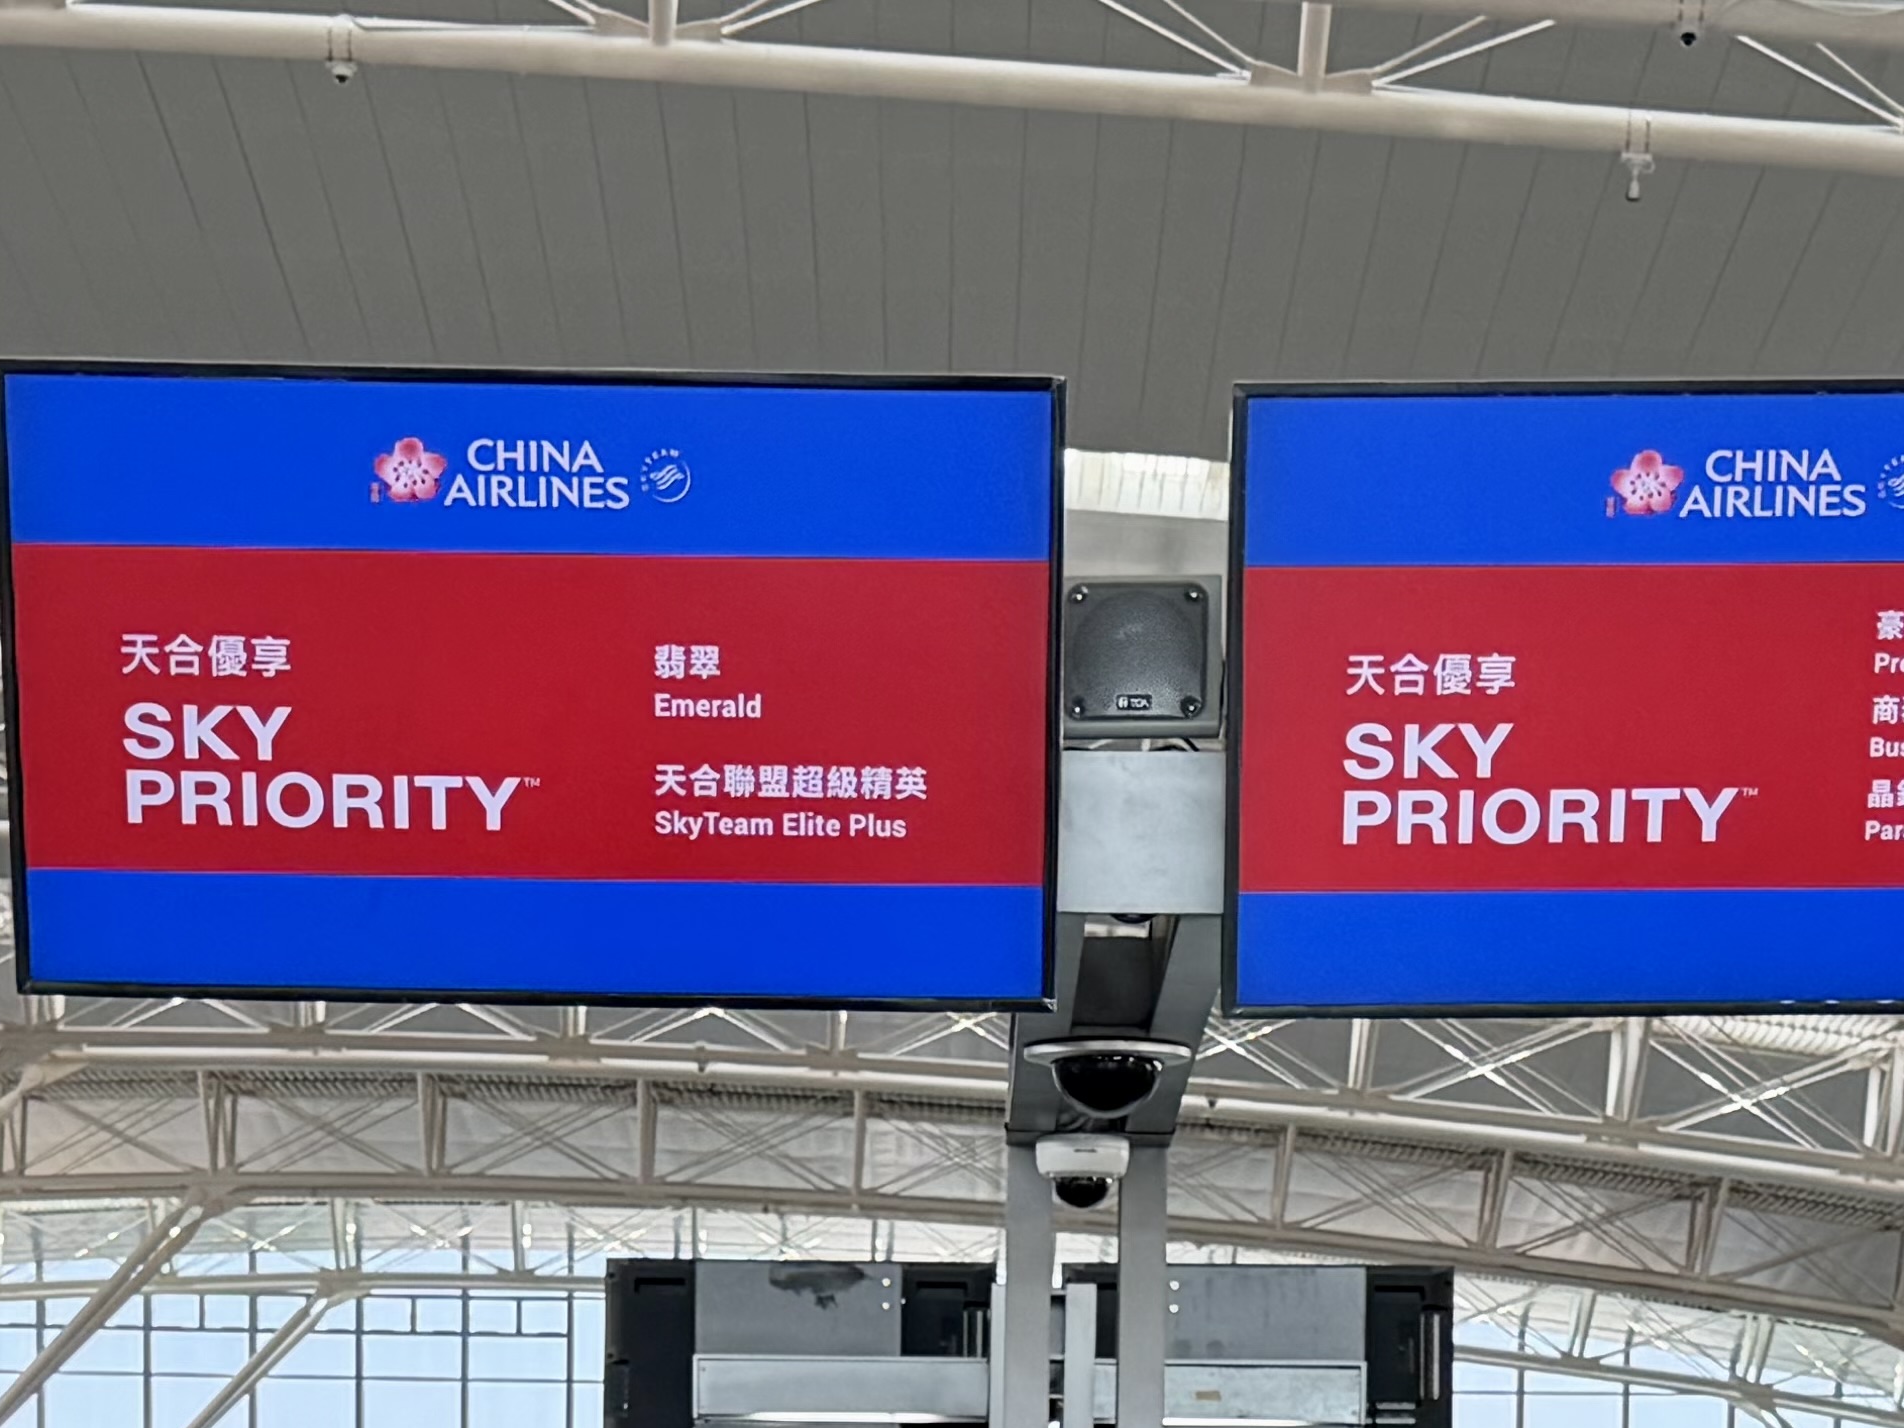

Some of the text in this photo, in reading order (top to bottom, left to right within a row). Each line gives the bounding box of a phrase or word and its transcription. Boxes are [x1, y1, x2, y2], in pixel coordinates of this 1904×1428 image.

[467, 438, 604, 473] CHINA
[1706, 448, 1841, 482] CHINA
[443, 474, 630, 509] AIRLINES
[1678, 485, 1866, 518] AIRLINES
[120, 633, 292, 678] 天合優享
[654, 644, 721, 679] 翡翠
[1346, 653, 1516, 696] 天合優享
[654, 693, 762, 718] Emerald
[123, 702, 293, 761] SKY
[1342, 722, 1515, 781] SKY
[654, 763, 928, 800] 天合聯盟超級精英
[126, 769, 522, 831] PRIORITY
[1343, 787, 1739, 845] PRIORITY
[654, 810, 907, 840] SkyTeam Elite Plus
